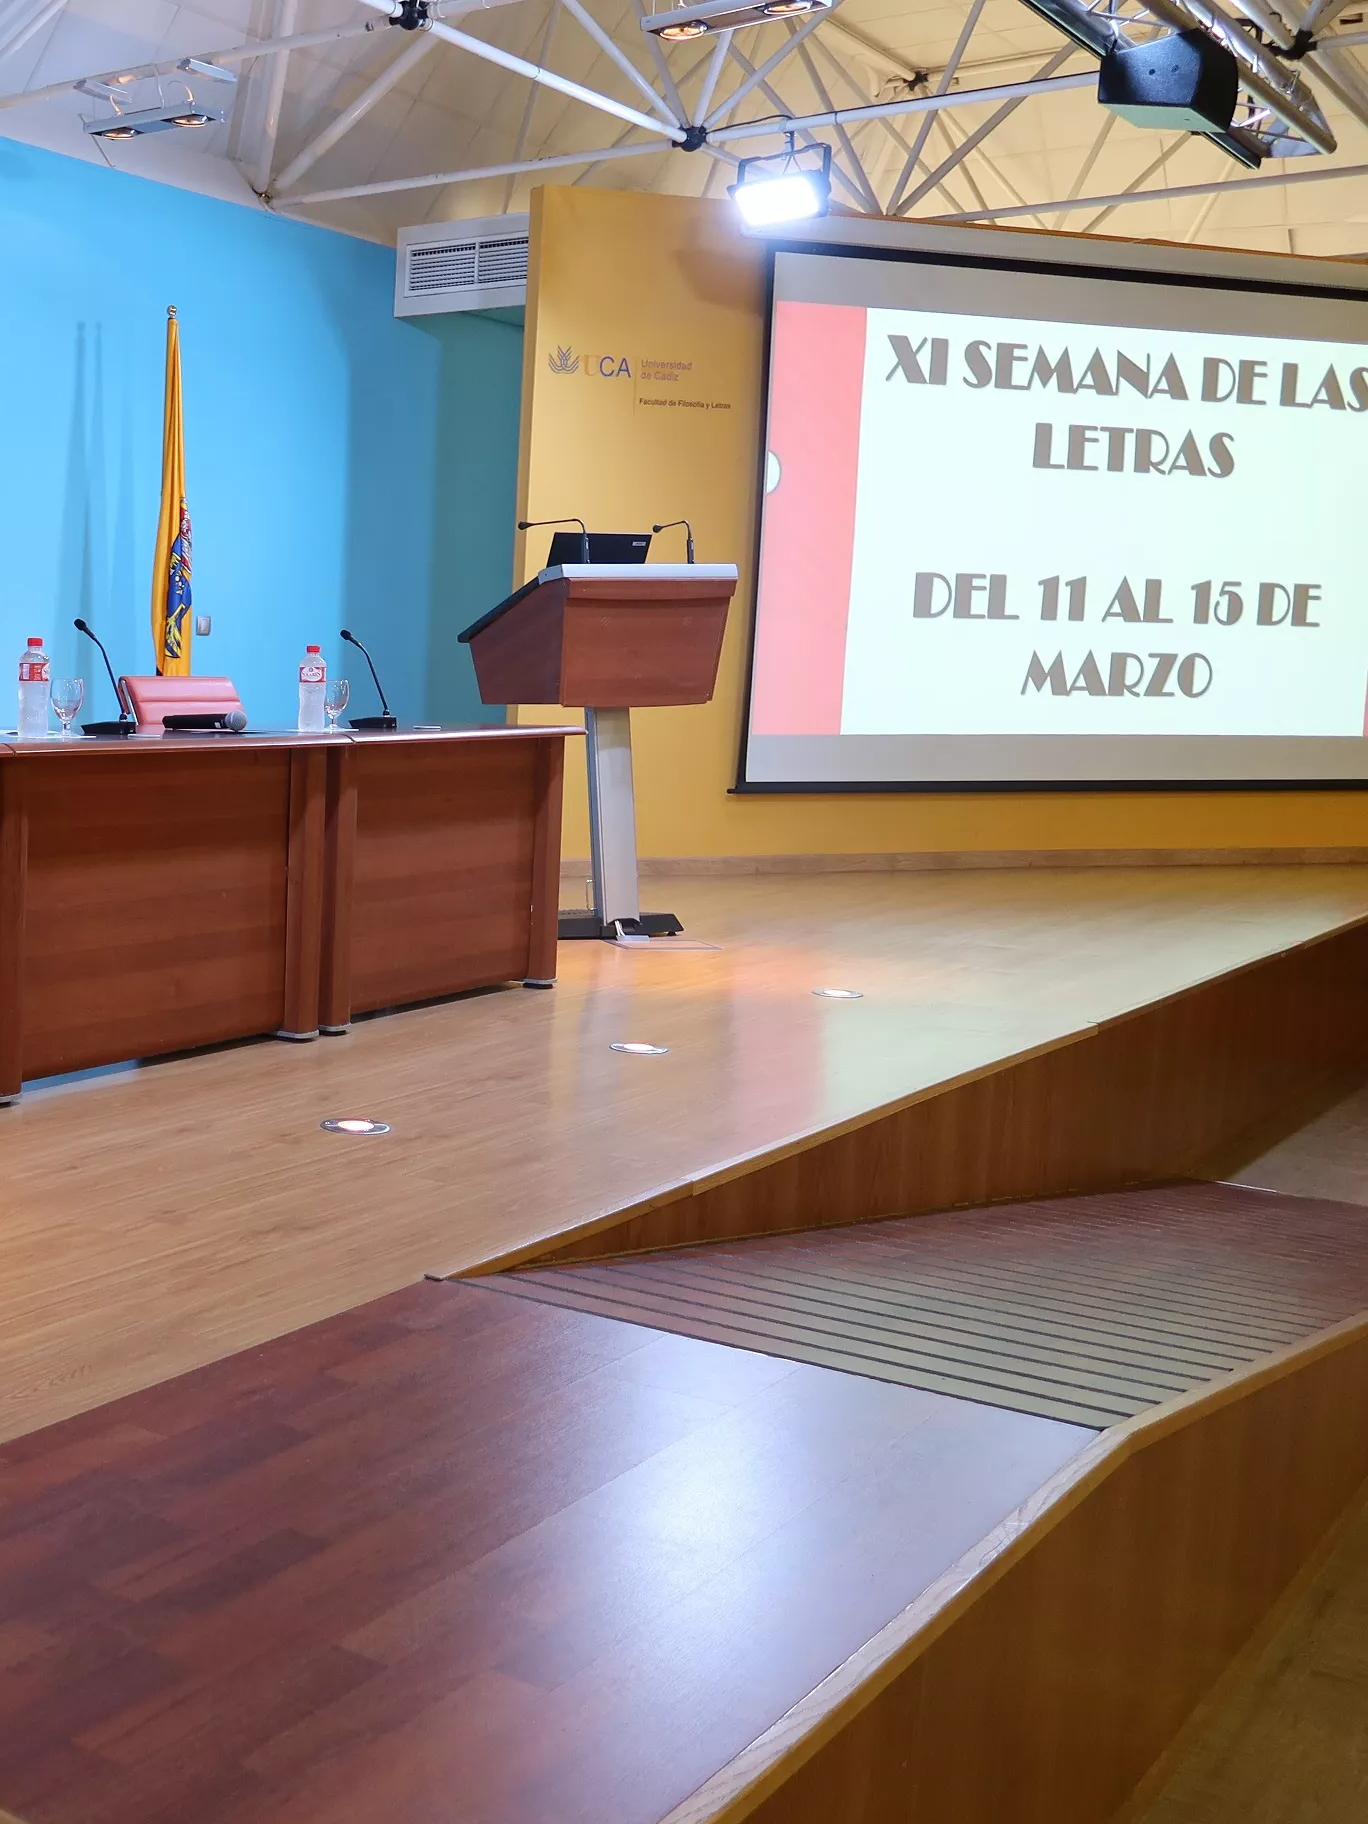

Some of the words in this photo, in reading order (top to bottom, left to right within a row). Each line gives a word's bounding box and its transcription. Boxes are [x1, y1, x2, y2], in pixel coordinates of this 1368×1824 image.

[583, 354, 631, 378] UCA
[640, 371, 652, 380] de
[641, 359, 693, 371] Universidad
[885, 334, 949, 386] XI
[963, 340, 1190, 401] SEMANA
[1200, 356, 1268, 406] DE
[1279, 362, 1368, 413] LAS
[639, 398, 667, 406] Facultad
[711, 402, 731, 410] Letras
[1032, 422, 1235, 479] LETRAS
[912, 572, 1020, 620] DEL
[1037, 575, 1087, 622] 11
[1101, 576, 1174, 624] AL
[1190, 580, 1244, 627] 15
[1256, 582, 1322, 628] DE
[1020, 649, 1213, 699] MARZO
